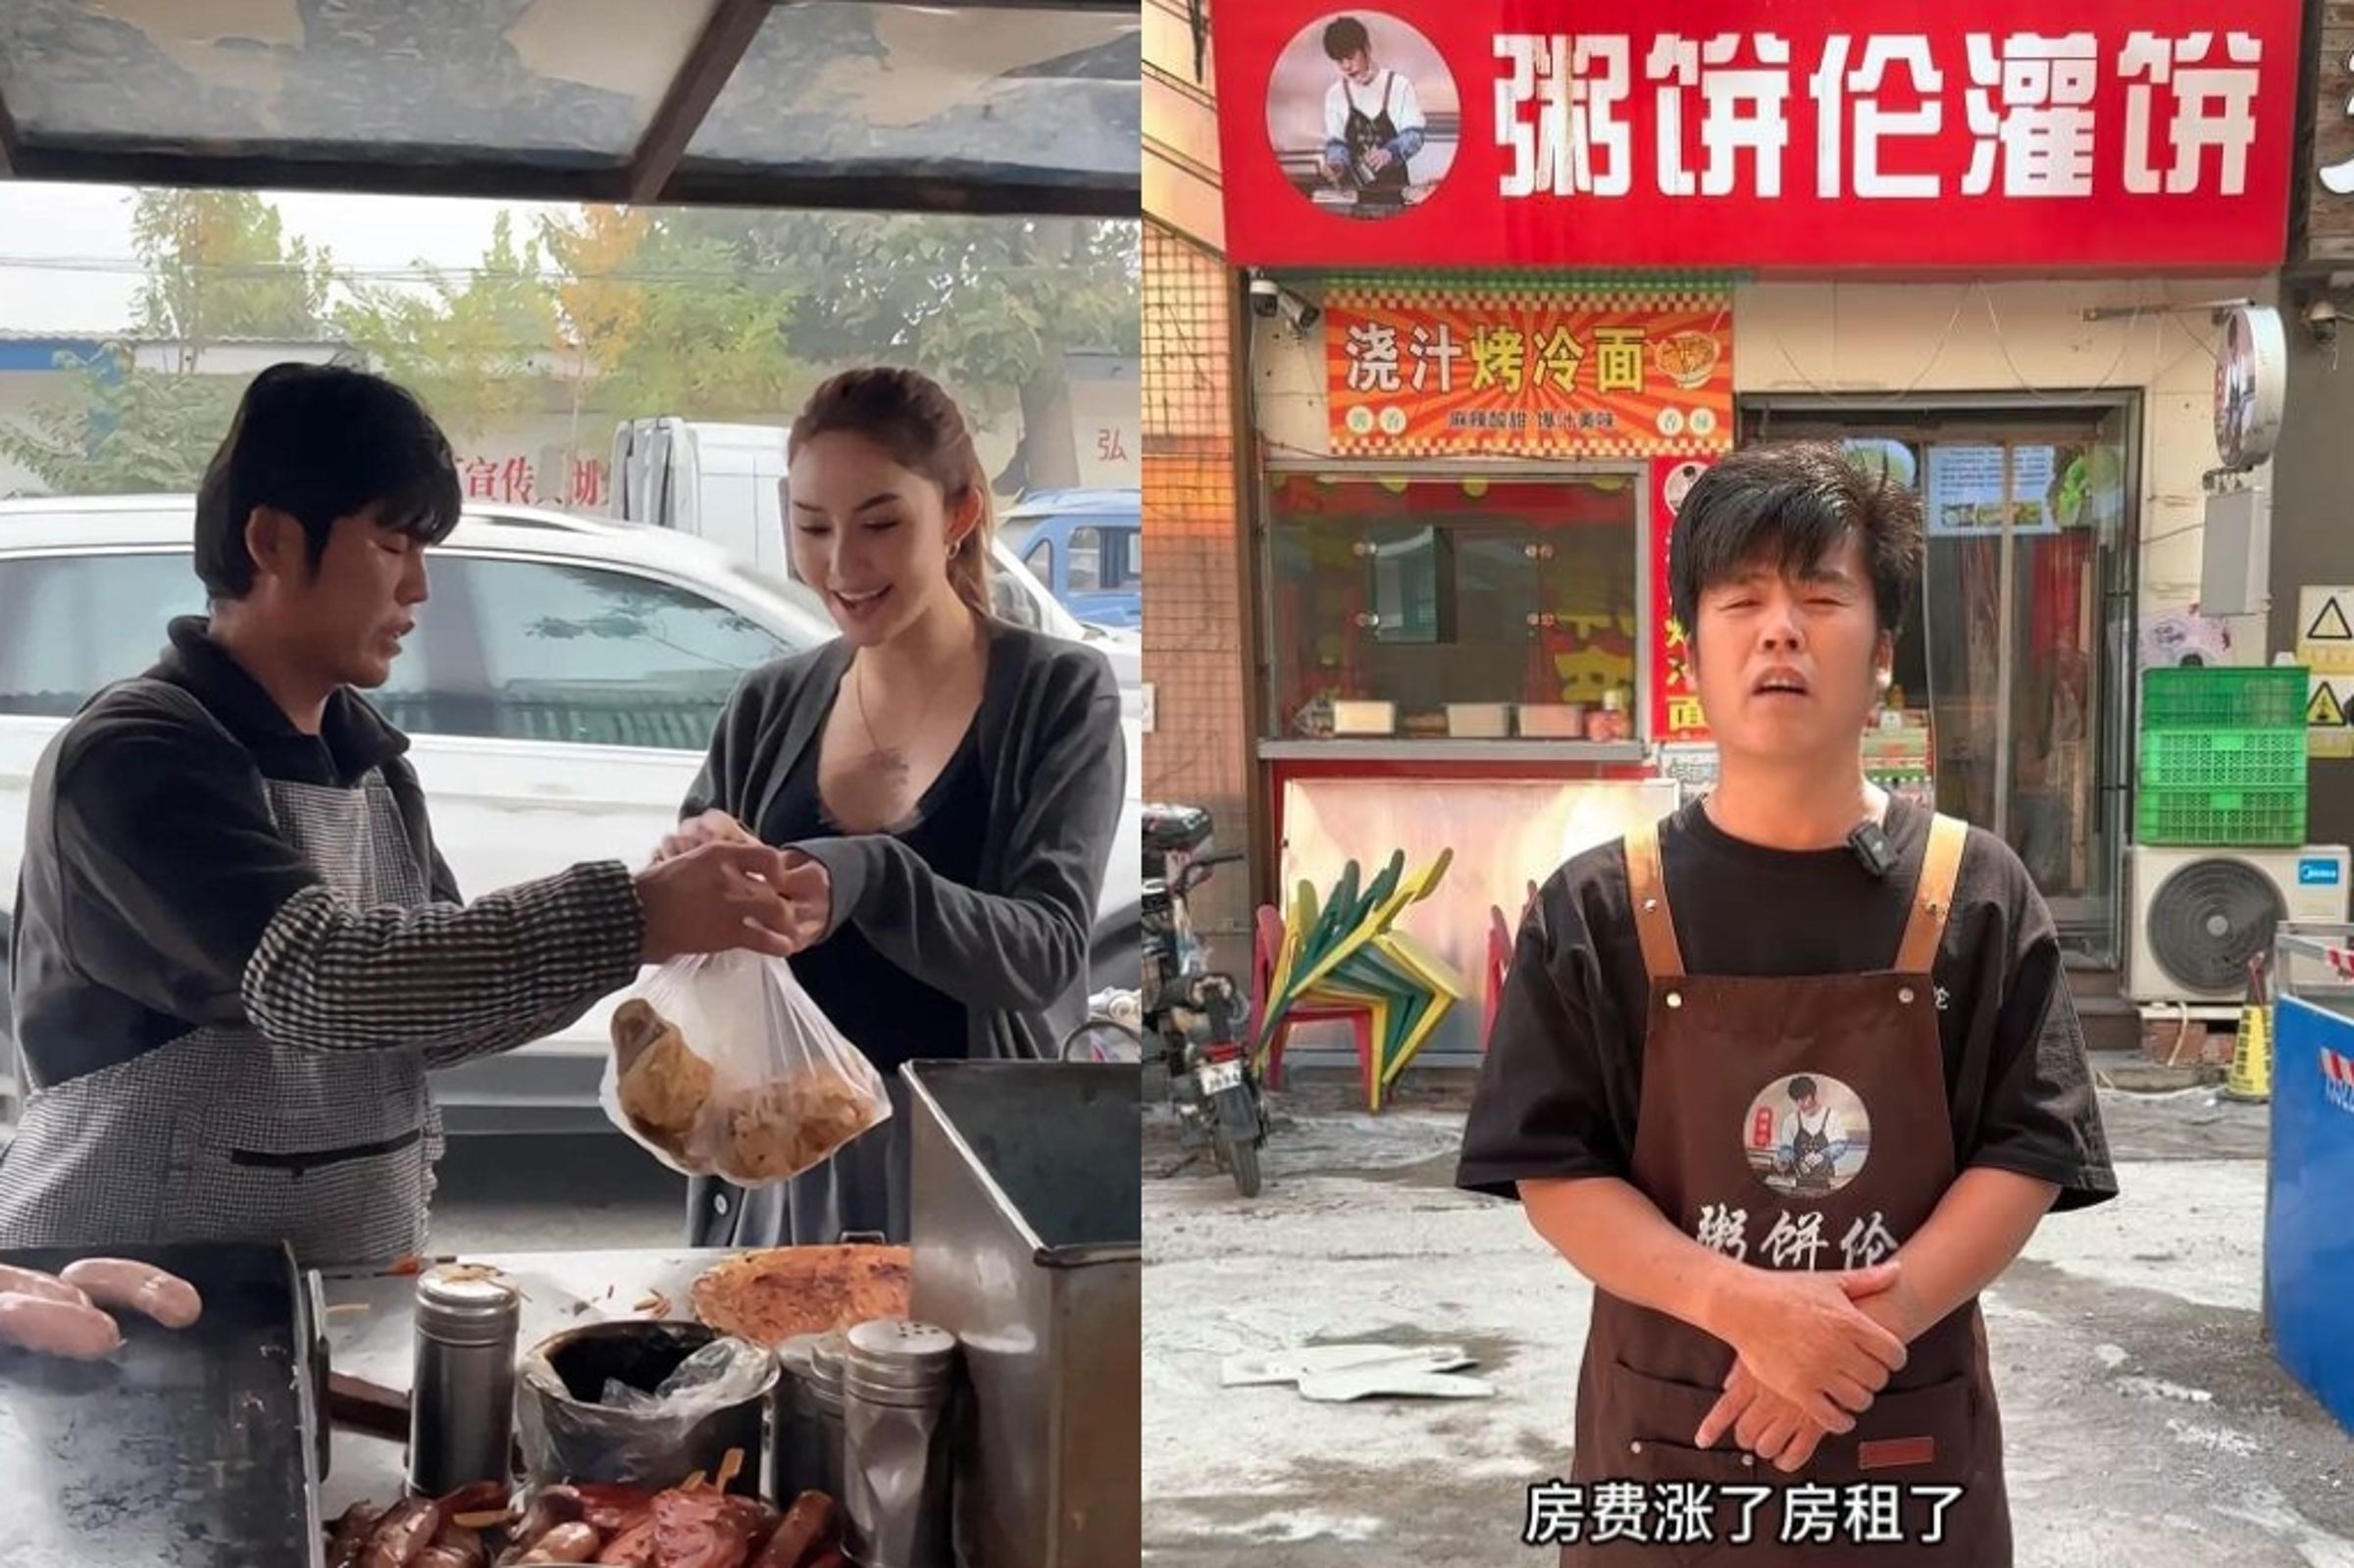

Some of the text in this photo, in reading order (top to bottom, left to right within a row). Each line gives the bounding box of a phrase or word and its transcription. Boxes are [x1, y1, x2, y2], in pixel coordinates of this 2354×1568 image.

[1493, 31, 2263, 199] 粥饼伦灌饼
[1345, 324, 1646, 394] 浇汁烤冷面
[1097, 427, 1128, 462] 弘
[1696, 1202, 1899, 1272] 粥饼伦
